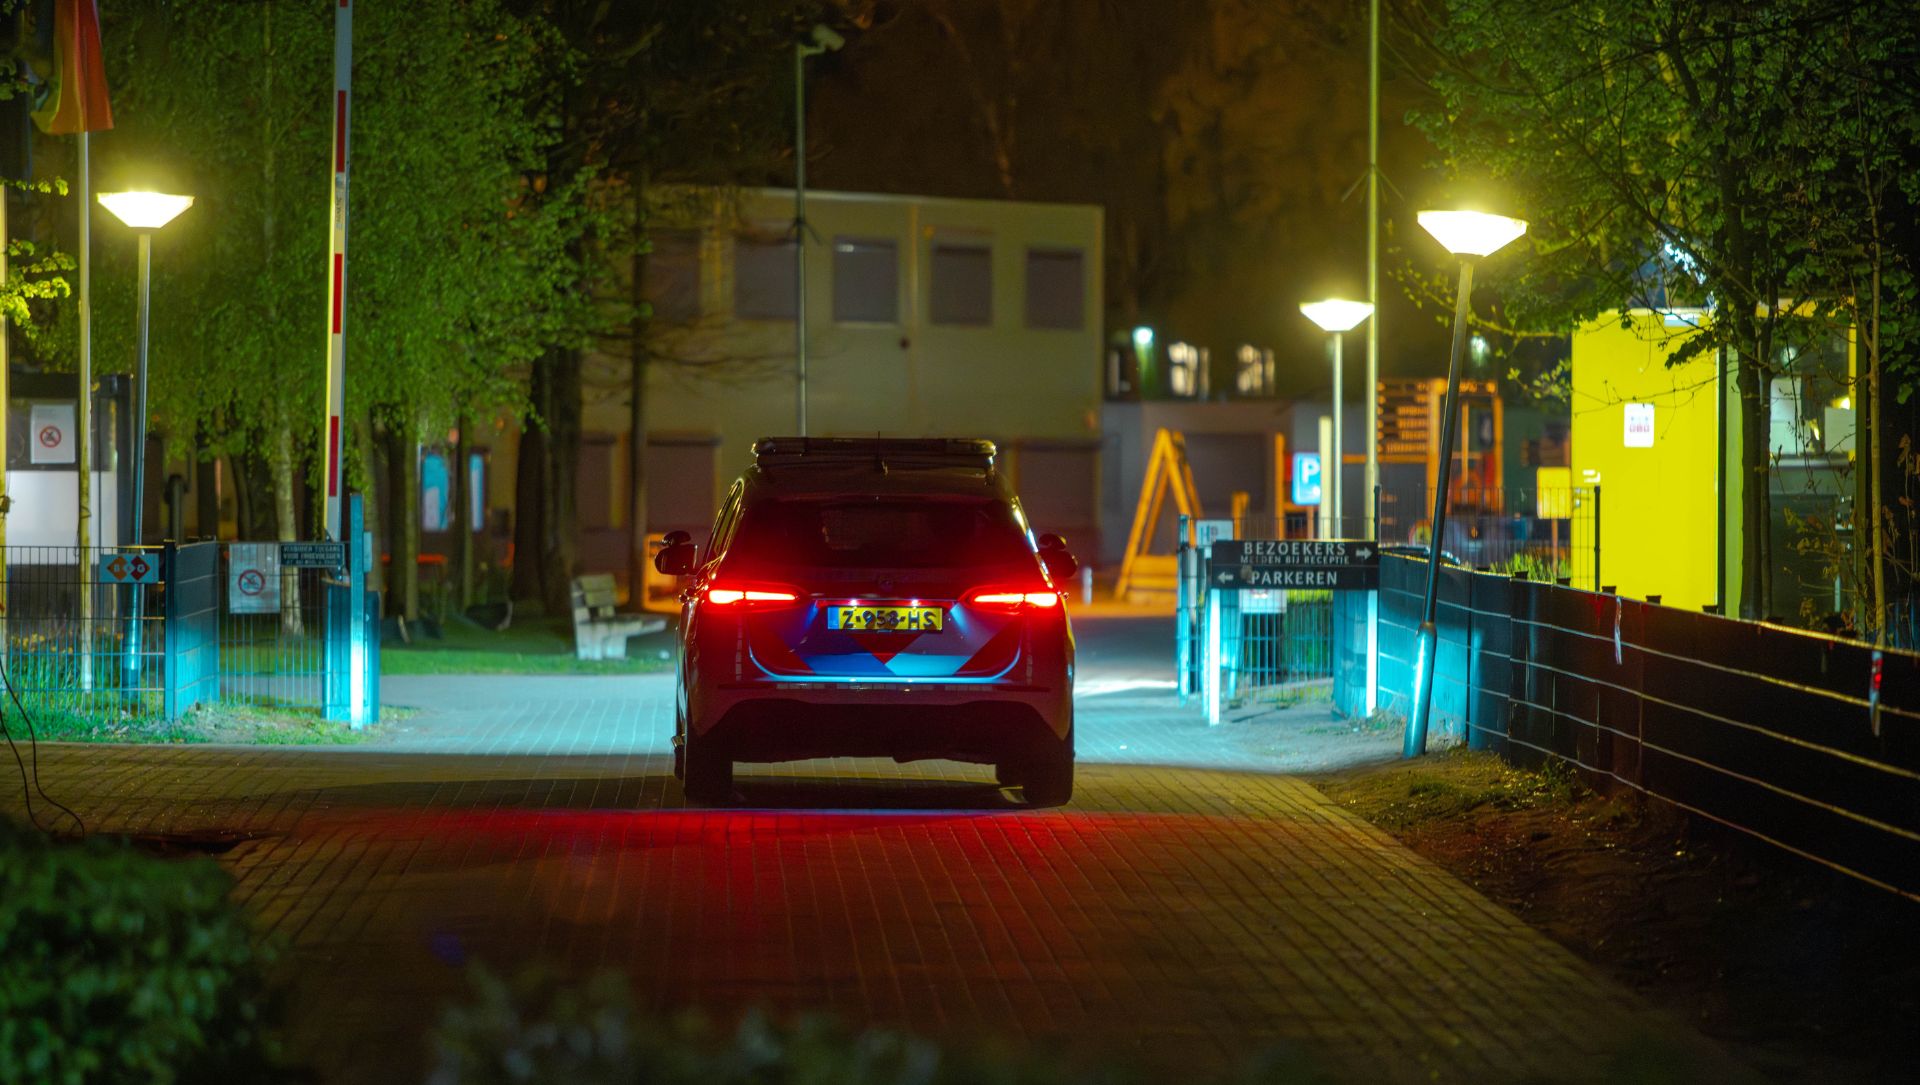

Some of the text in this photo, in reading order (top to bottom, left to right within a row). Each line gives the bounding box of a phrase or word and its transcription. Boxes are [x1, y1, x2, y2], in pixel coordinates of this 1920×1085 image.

[1244, 542, 1346, 556] BEZOEKERS
[1240, 555, 1350, 565] MELDEN BIJ RECEPTIE
[1252, 571, 1338, 586] PARKEREN
